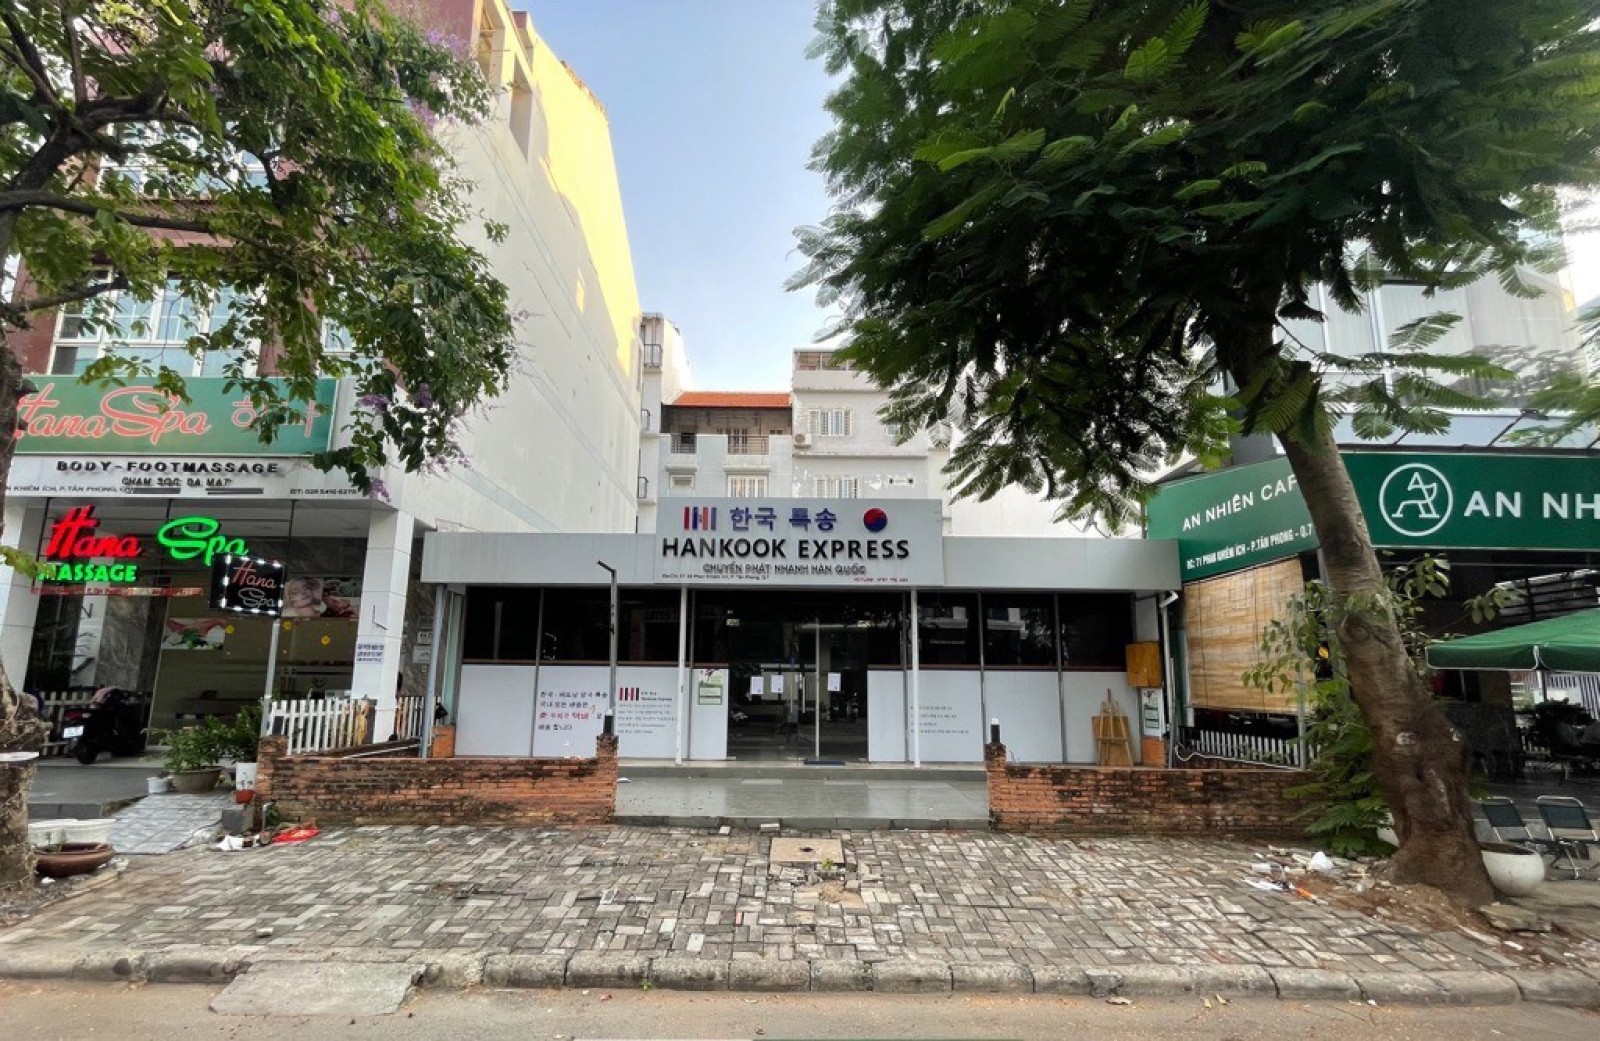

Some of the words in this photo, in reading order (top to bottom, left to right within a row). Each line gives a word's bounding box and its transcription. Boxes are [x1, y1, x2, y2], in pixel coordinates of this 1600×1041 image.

[1182, 513, 1200, 532] AN
[1205, 491, 1254, 523] NHIÊN
[1463, 490, 1521, 518] AN
[729, 507, 777, 531] 한국
[44, 504, 142, 558] Hana
[157, 516, 248, 567] Spa
[662, 537, 786, 558] HANKOOK
[797, 540, 909, 559] EXPRESS
[232, 559, 277, 588] Hana
[774, 563, 809, 575] NHANH
[238, 587, 275, 608] Spa
